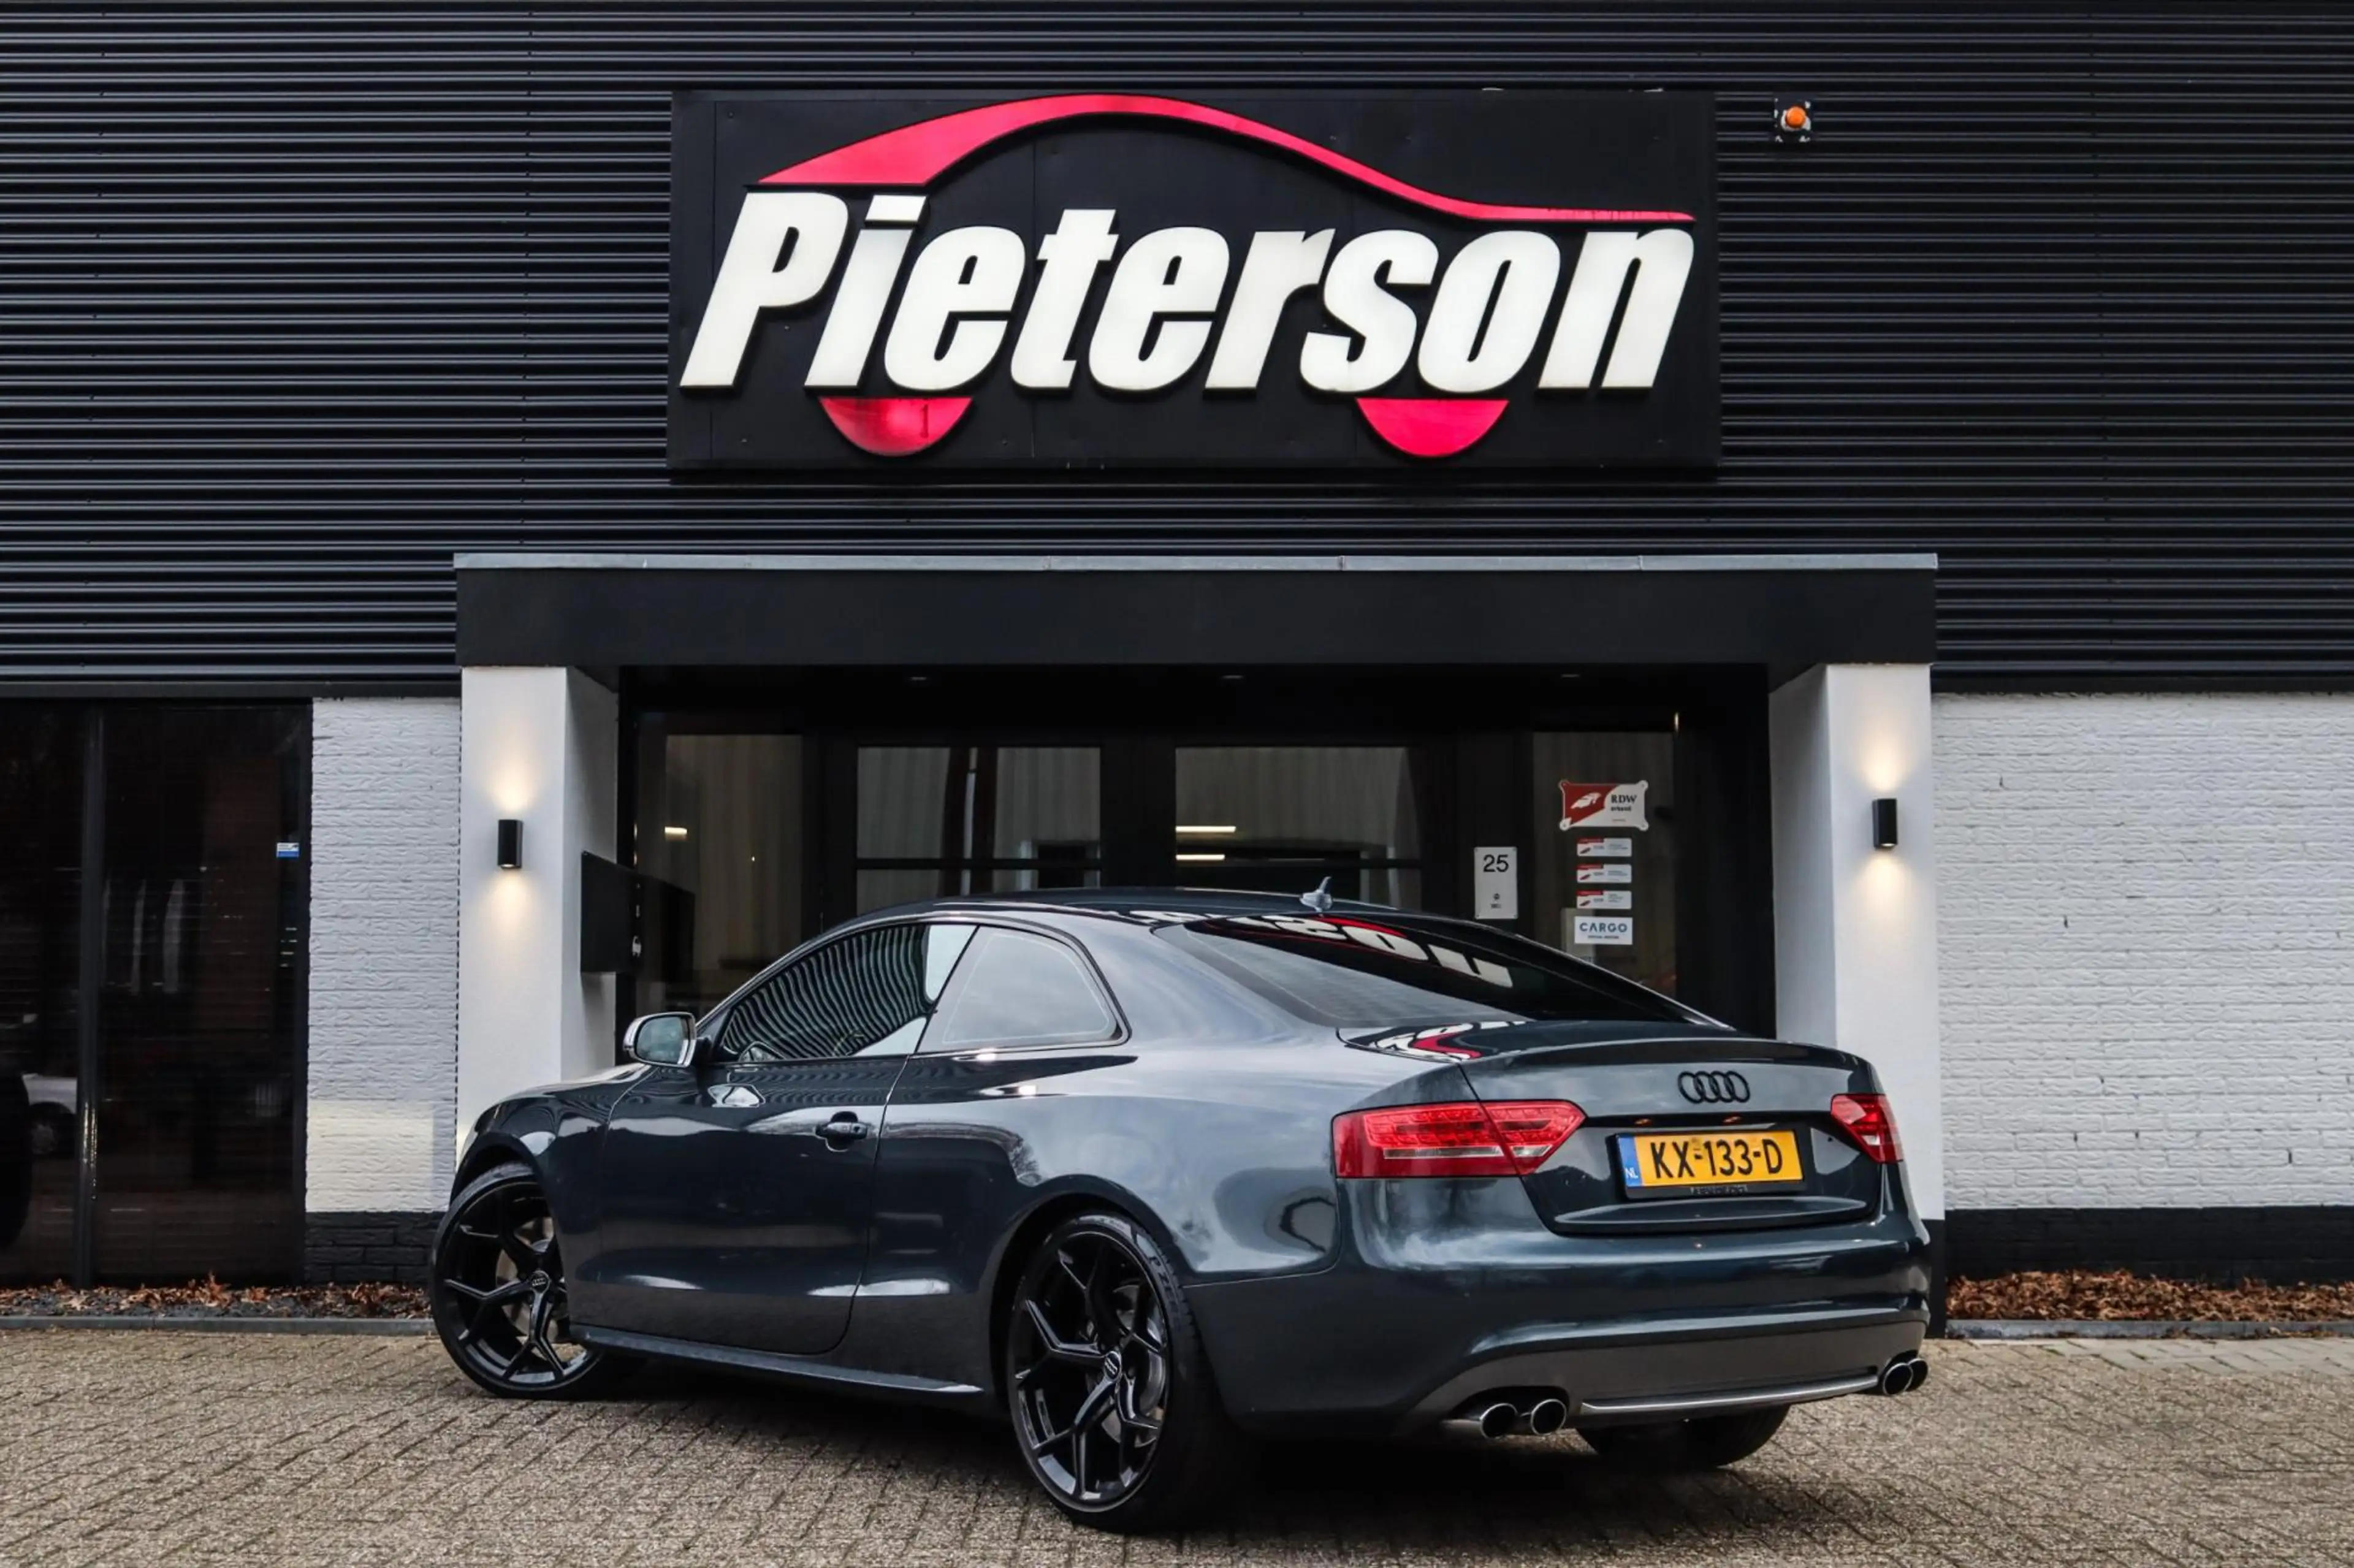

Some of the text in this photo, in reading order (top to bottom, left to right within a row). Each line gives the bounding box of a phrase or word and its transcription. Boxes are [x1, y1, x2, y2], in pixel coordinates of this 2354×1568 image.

[679, 191, 1694, 393] Pieterson
[1610, 794, 1637, 804] RDW
[1483, 854, 1509, 873] 25
[1579, 922, 1628, 933] CARGO
[1650, 1138, 1783, 1179] KX-133-D
[1625, 1166, 1639, 1179] NL
